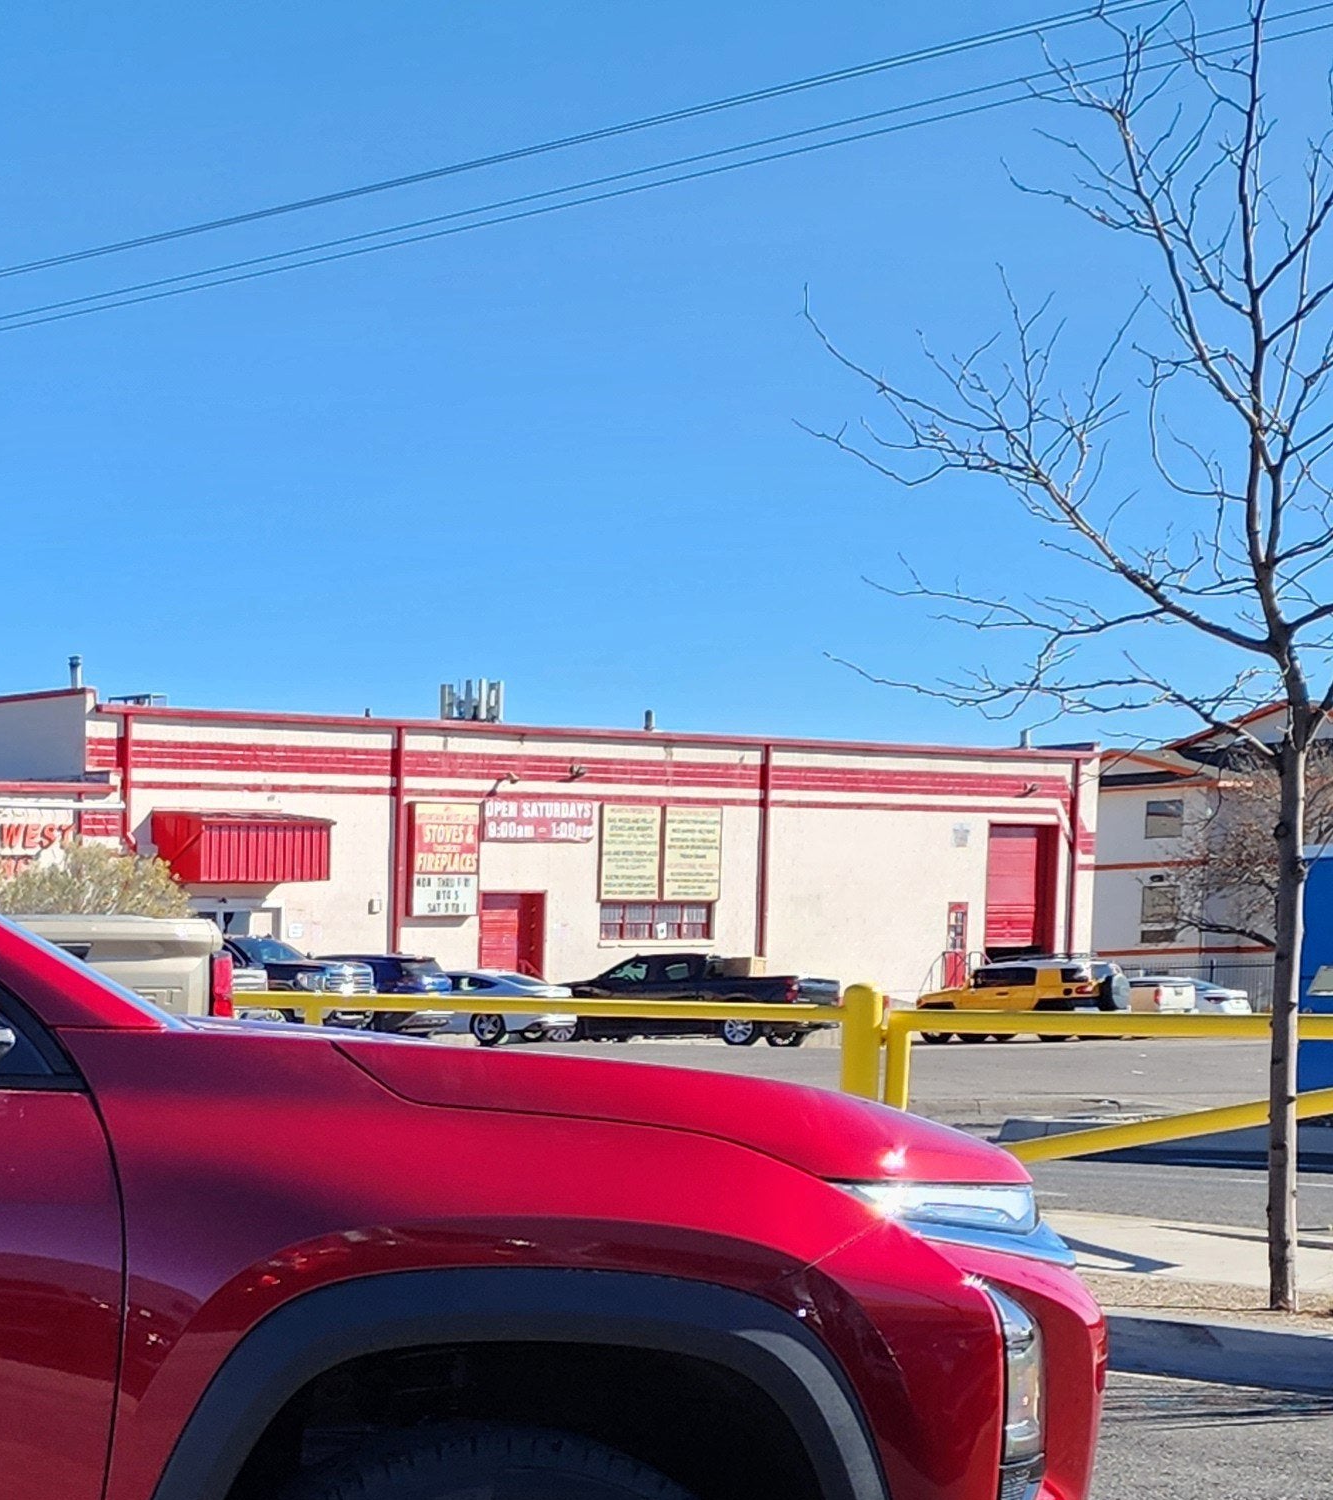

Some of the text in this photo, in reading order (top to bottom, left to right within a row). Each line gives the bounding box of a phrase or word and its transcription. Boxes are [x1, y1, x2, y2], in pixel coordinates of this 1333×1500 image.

[485, 800, 519, 818] OPEN
[522, 801, 593, 819] SATURDAYS
[423, 824, 464, 844] STOVES
[416, 852, 479, 873] FIREPLACES
[427, 902, 441, 913] SAT
